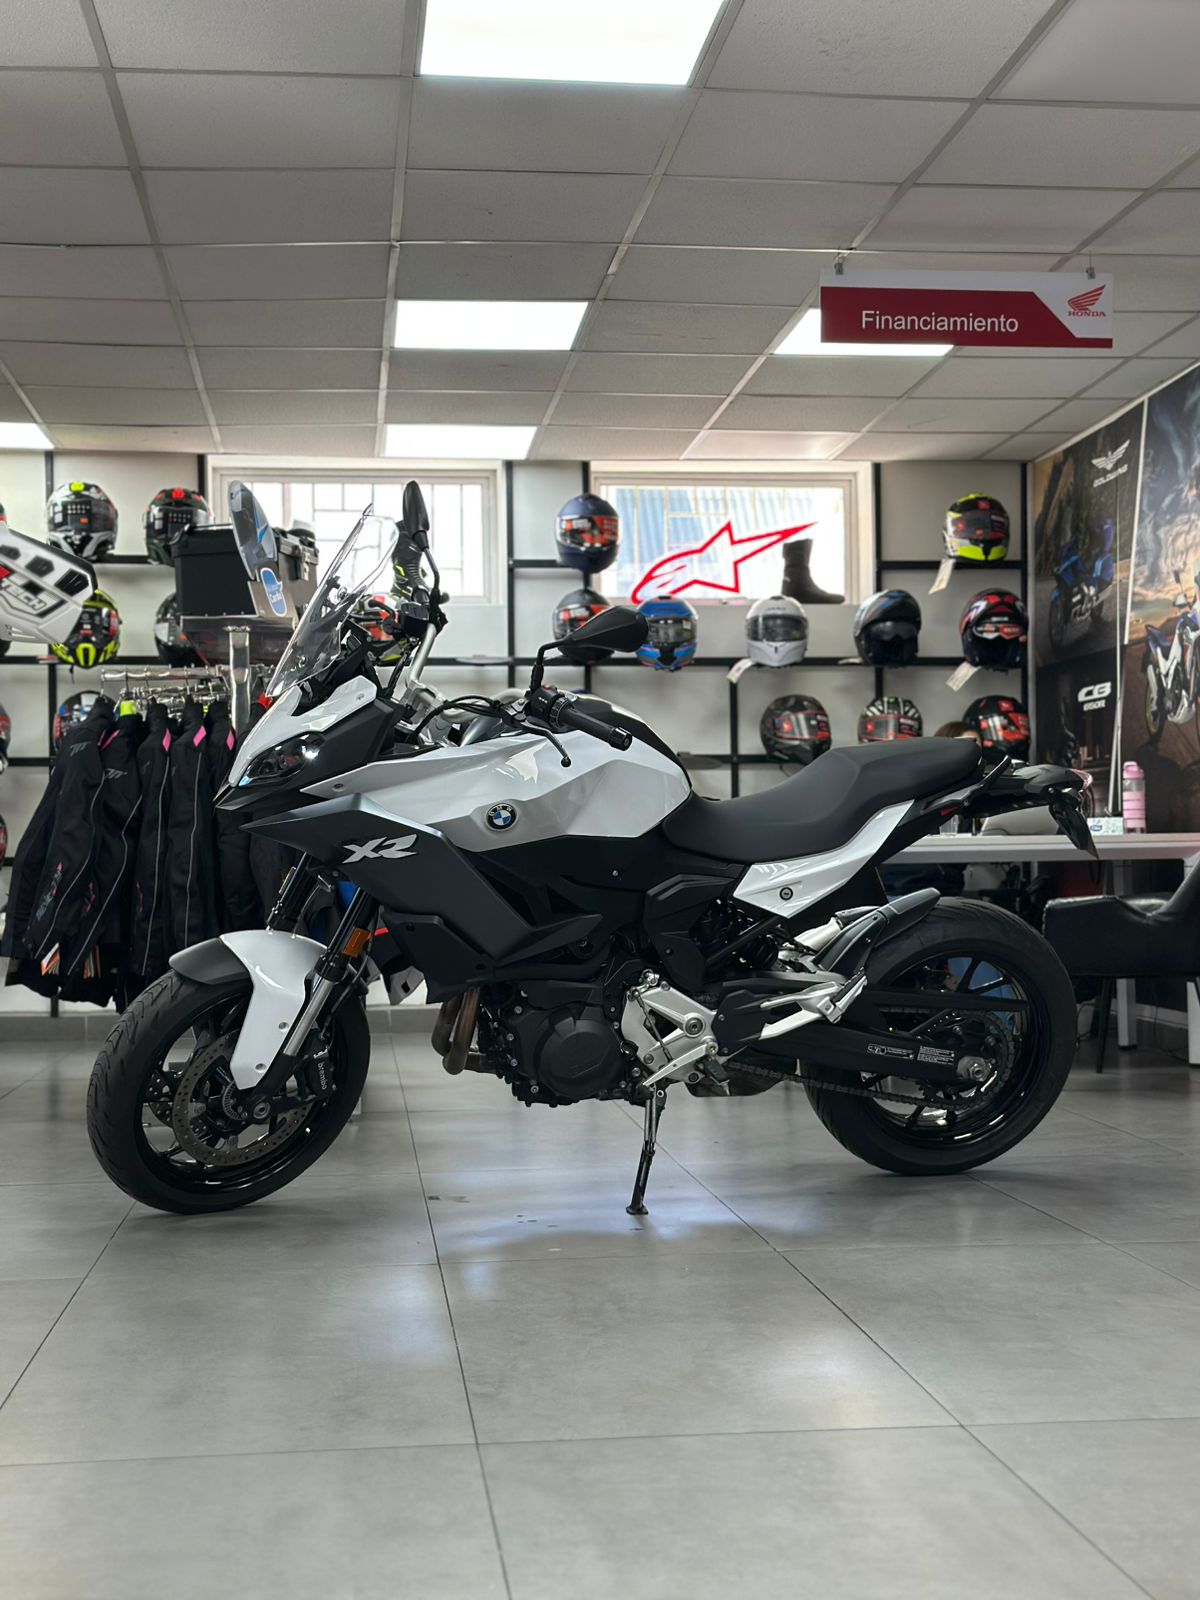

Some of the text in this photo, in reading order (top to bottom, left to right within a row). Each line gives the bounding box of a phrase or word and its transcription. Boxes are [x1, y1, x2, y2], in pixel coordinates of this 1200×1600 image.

[861, 310, 1019, 332] Financiamiento
[1077, 681, 1112, 702] CB
[317, 1061, 328, 1090] brembo
